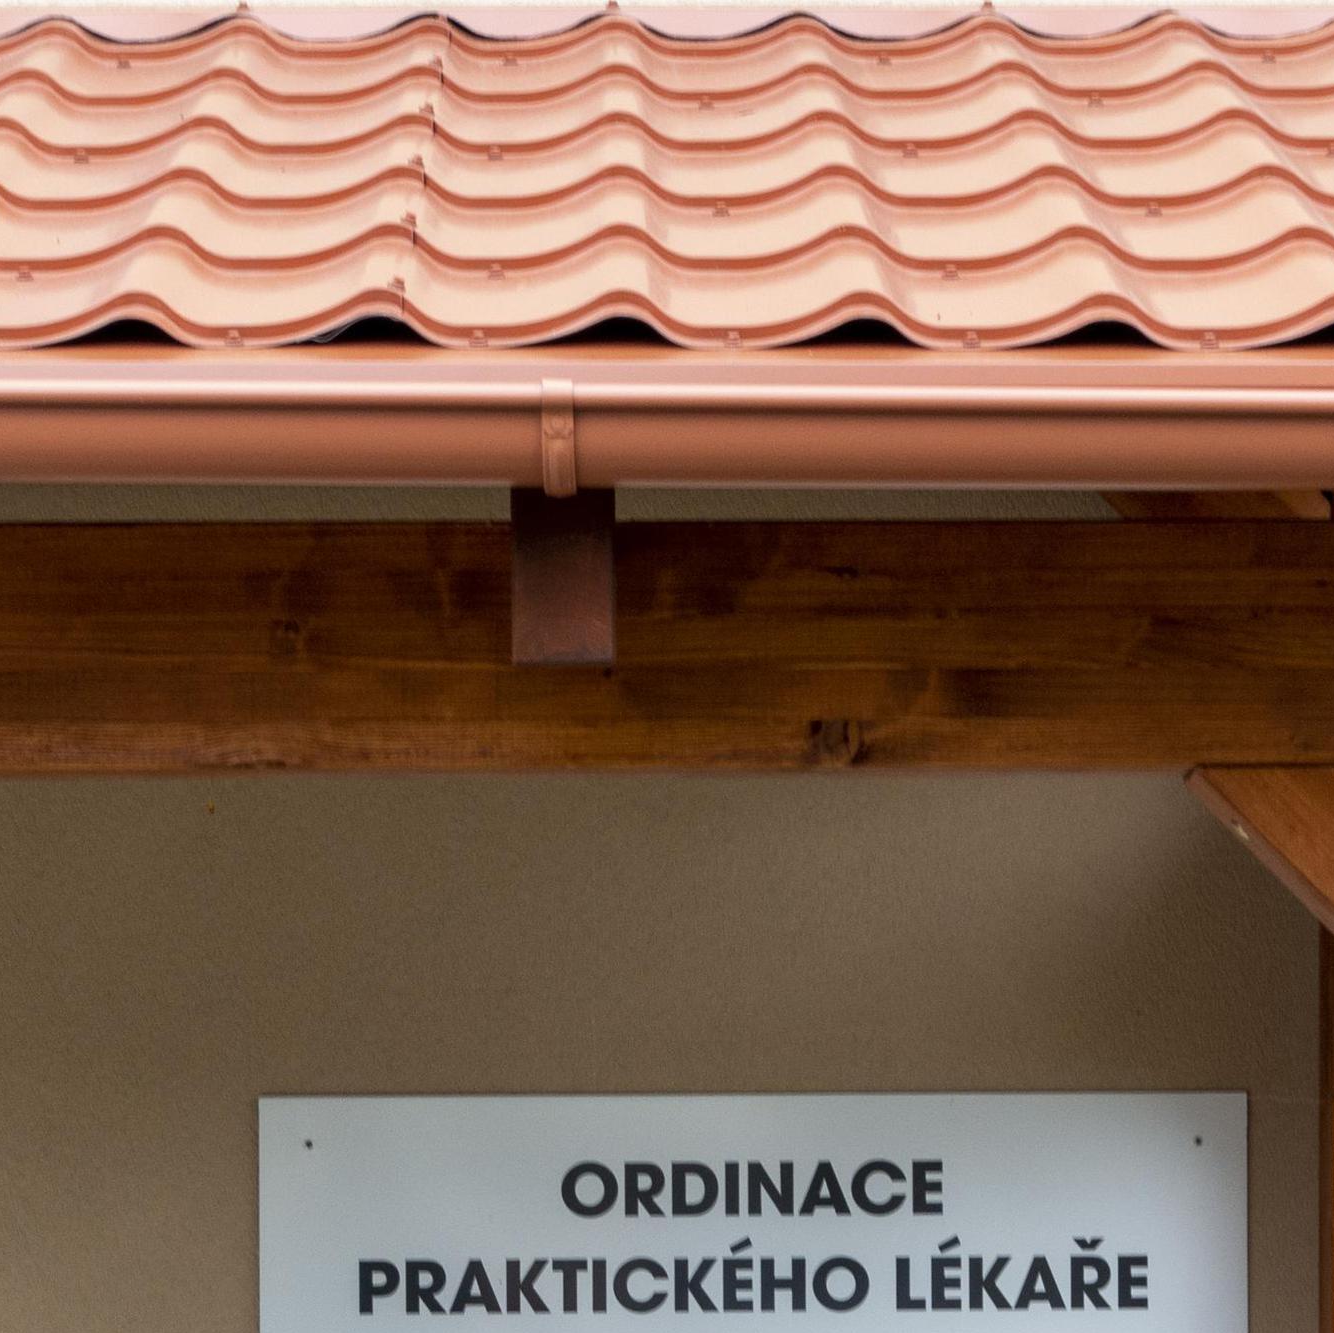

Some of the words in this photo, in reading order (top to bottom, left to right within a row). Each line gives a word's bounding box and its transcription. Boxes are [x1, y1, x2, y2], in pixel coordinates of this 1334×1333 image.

[558, 1157, 944, 1220] ORDINACE
[357, 1236, 871, 1317] PRAKTICKÉHO
[895, 1234, 1149, 1313] LÉKAŘE
